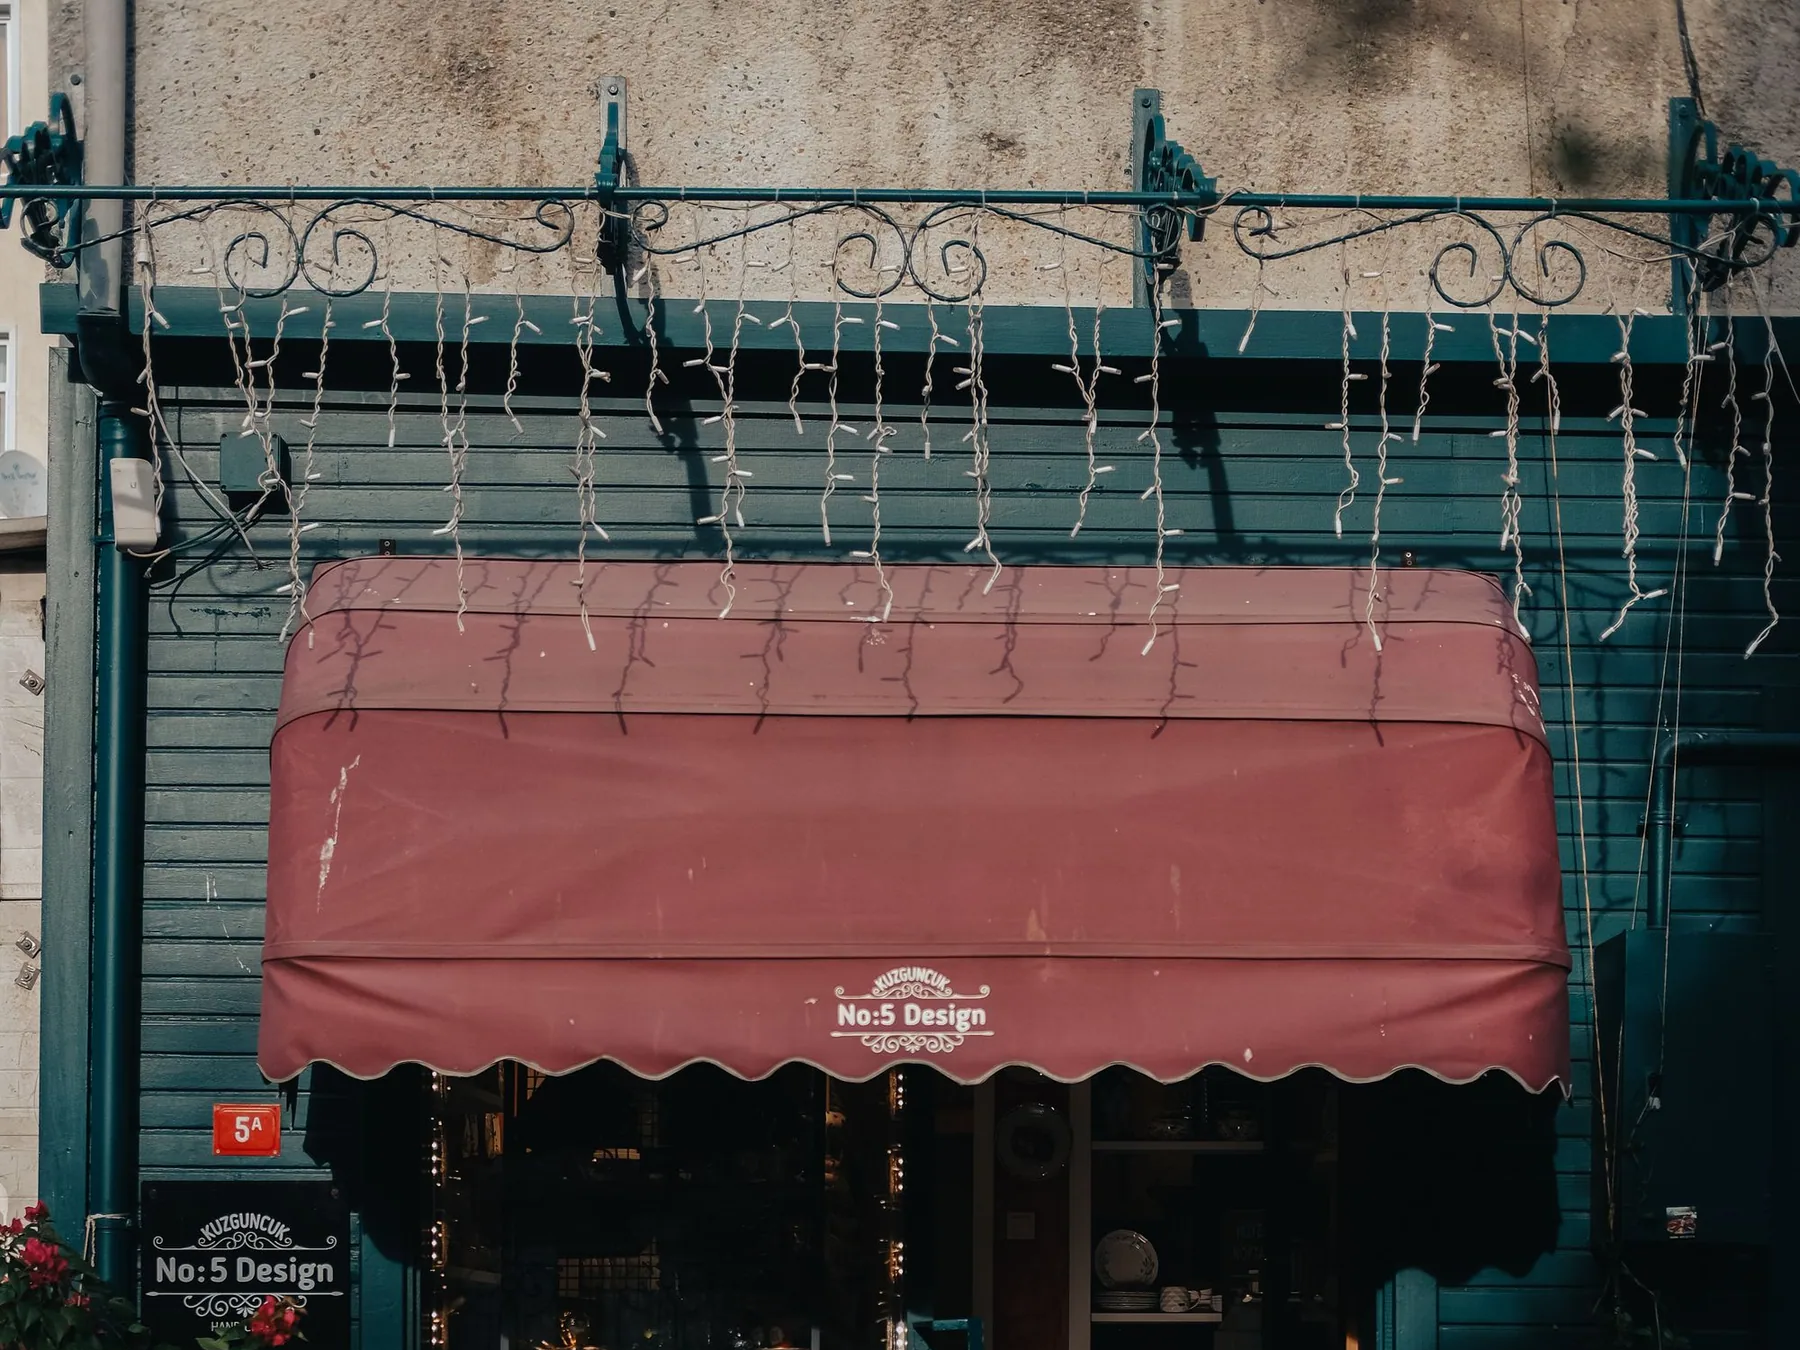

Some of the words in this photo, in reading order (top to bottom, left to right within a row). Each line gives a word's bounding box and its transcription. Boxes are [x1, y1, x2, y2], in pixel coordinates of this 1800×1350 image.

[874, 966, 951, 991] KUZGUNCUK
[837, 1003, 896, 1026] No:5
[904, 1003, 986, 1033] Design
[234, 1116, 263, 1143] 5A
[200, 1213, 291, 1241] KUZGUNCUK
[236, 1256, 334, 1290] Design
